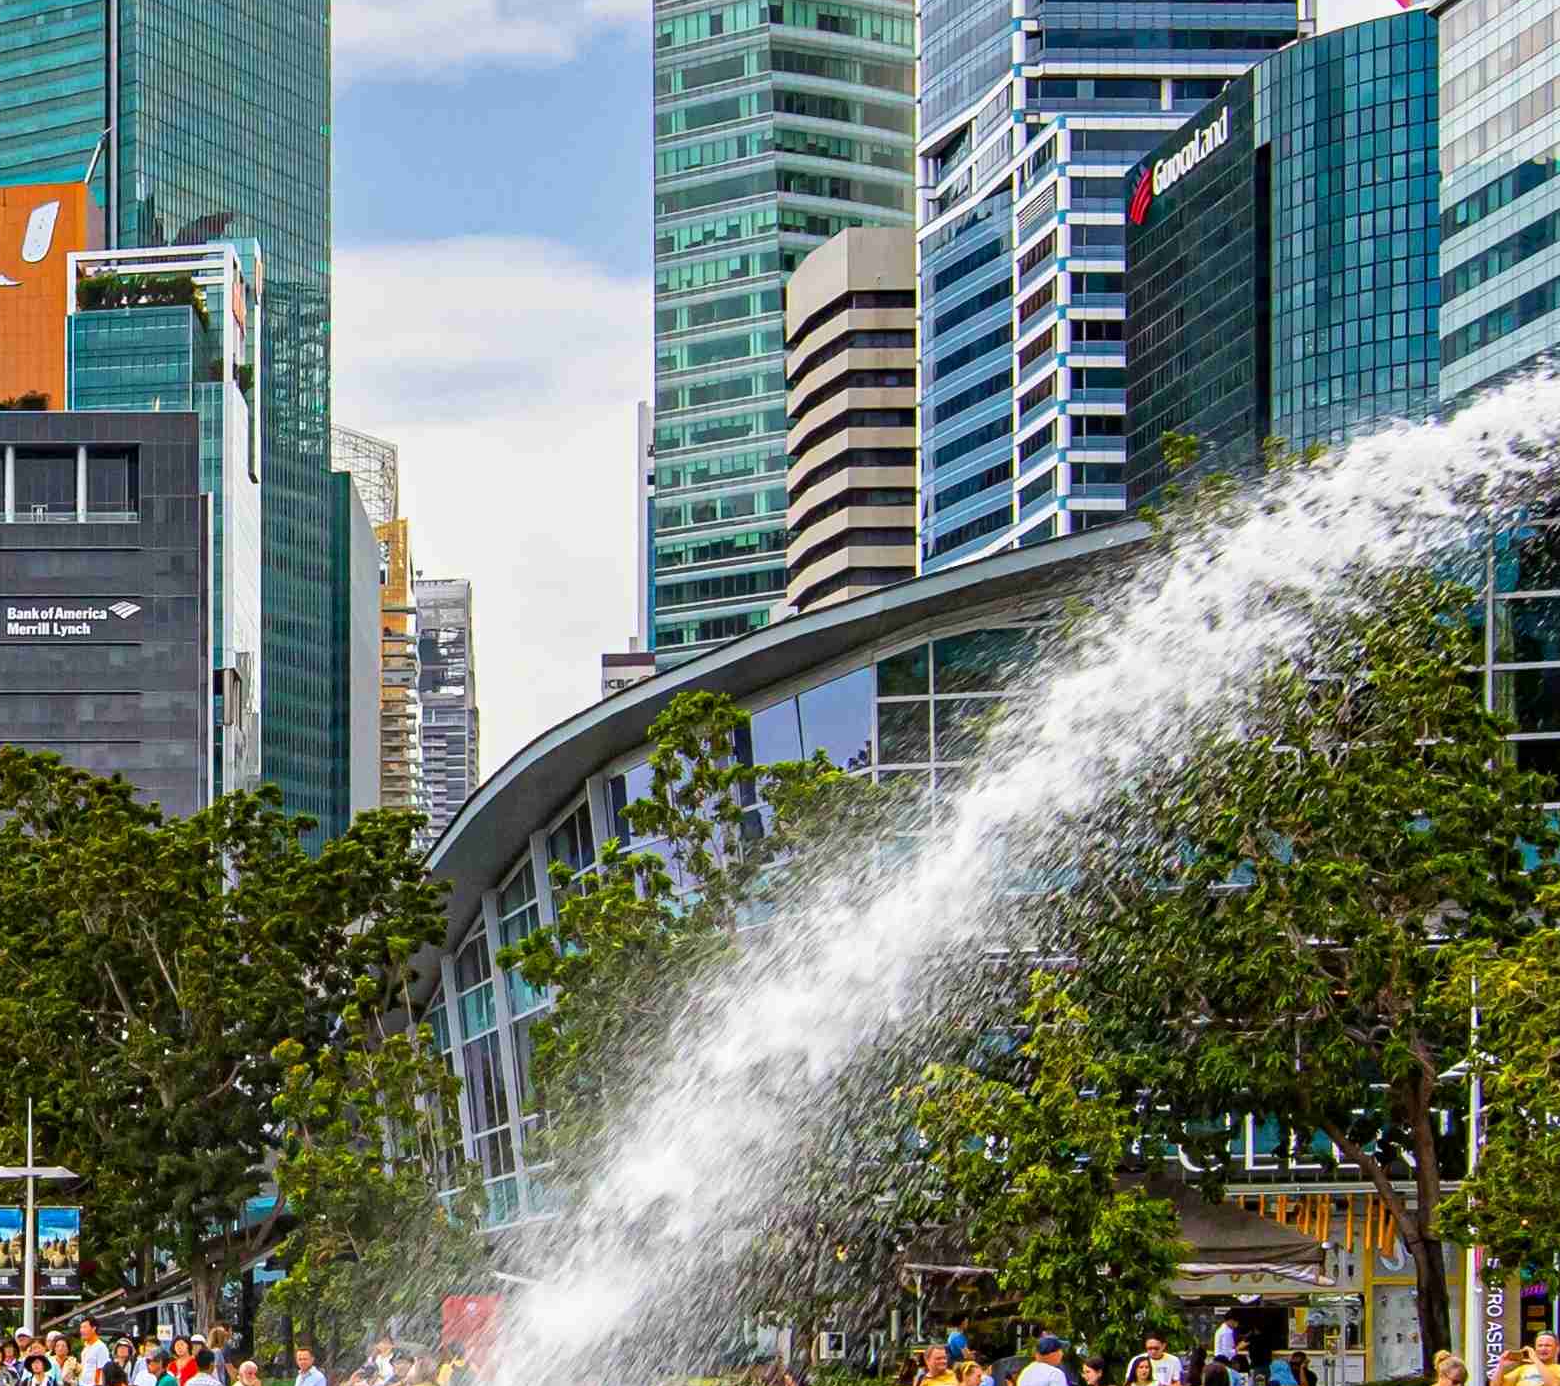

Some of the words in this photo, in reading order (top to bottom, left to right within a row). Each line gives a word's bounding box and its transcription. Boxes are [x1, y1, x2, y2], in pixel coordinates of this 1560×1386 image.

[7, 607, 40, 620] Bank
[40, 607, 55, 620] of
[54, 607, 108, 620] America
[7, 622, 50, 635] Merrill
[53, 622, 91, 637] Lynch
